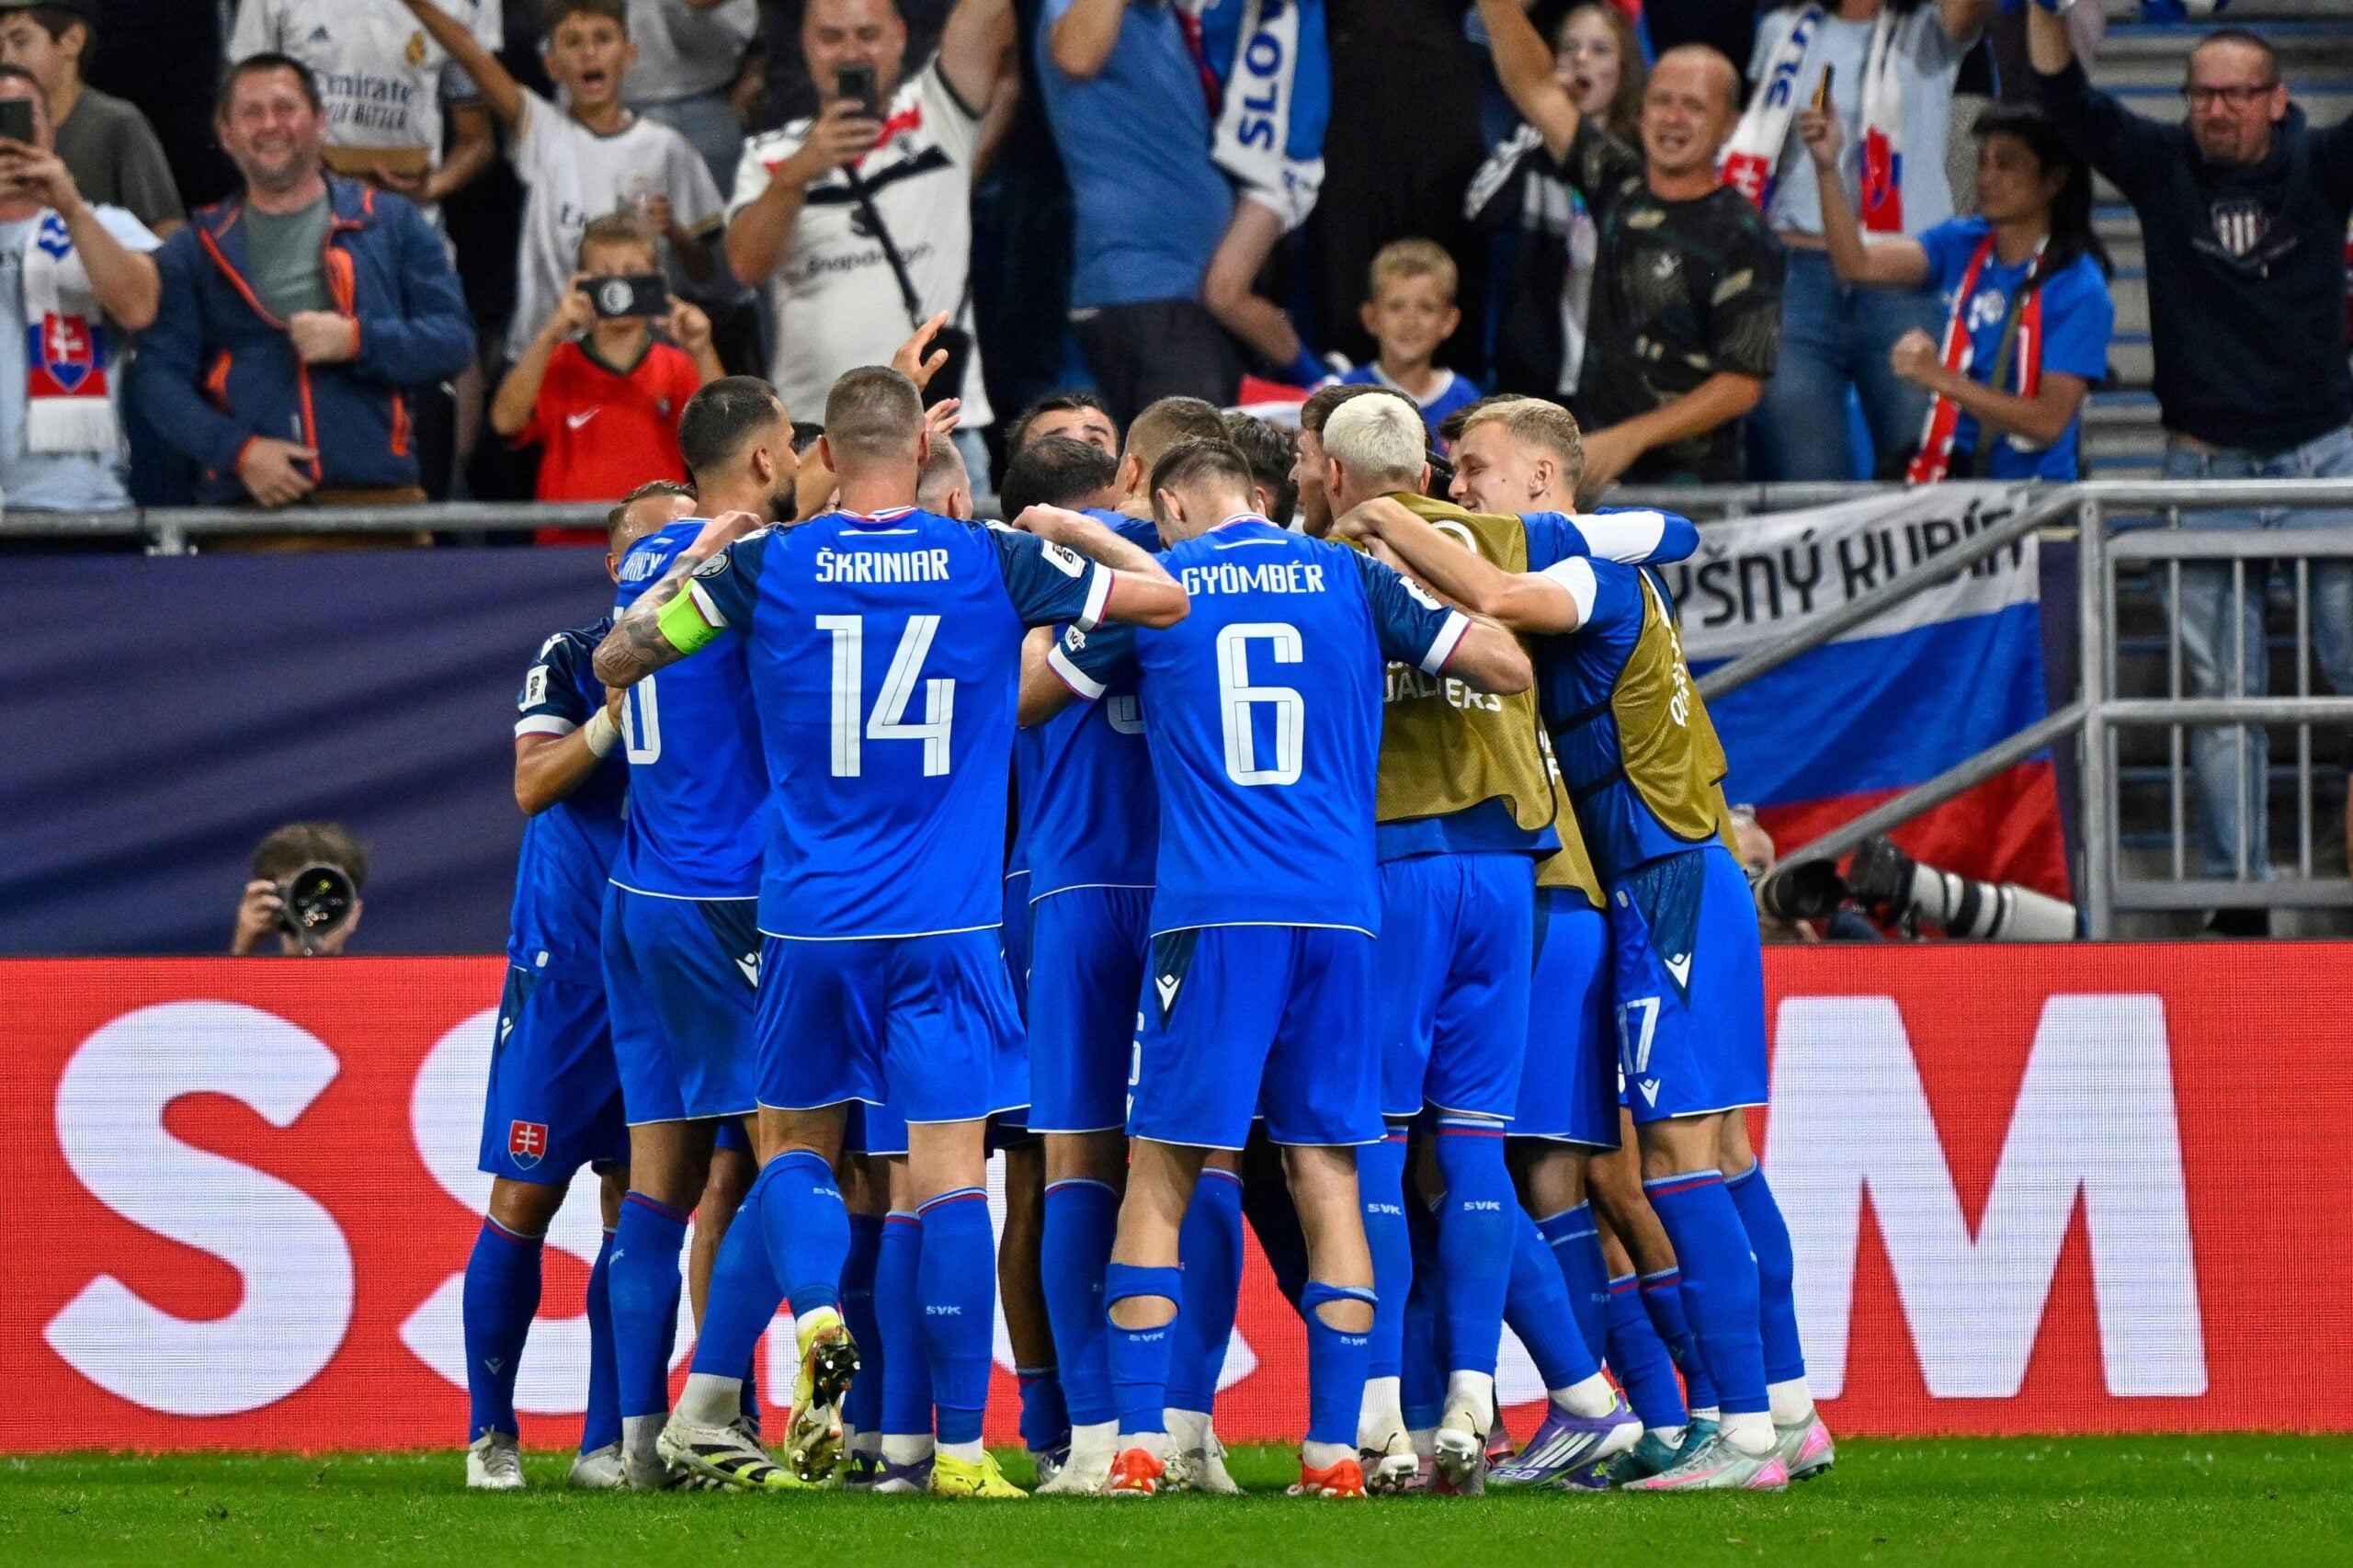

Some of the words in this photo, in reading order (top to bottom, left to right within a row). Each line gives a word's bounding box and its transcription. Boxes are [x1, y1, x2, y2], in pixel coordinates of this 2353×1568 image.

[815, 547, 950, 583] ŠKRINIAR
[1181, 560, 1326, 596] GYÖMBÉR
[1672, 528, 1823, 628] YŠNÝ
[815, 615, 956, 778] 14
[1216, 622, 1304, 787] 6
[1368, 1203, 1402, 1216] SVK
[1463, 1200, 1502, 1211] SVK
[926, 1305, 962, 1316] SVK
